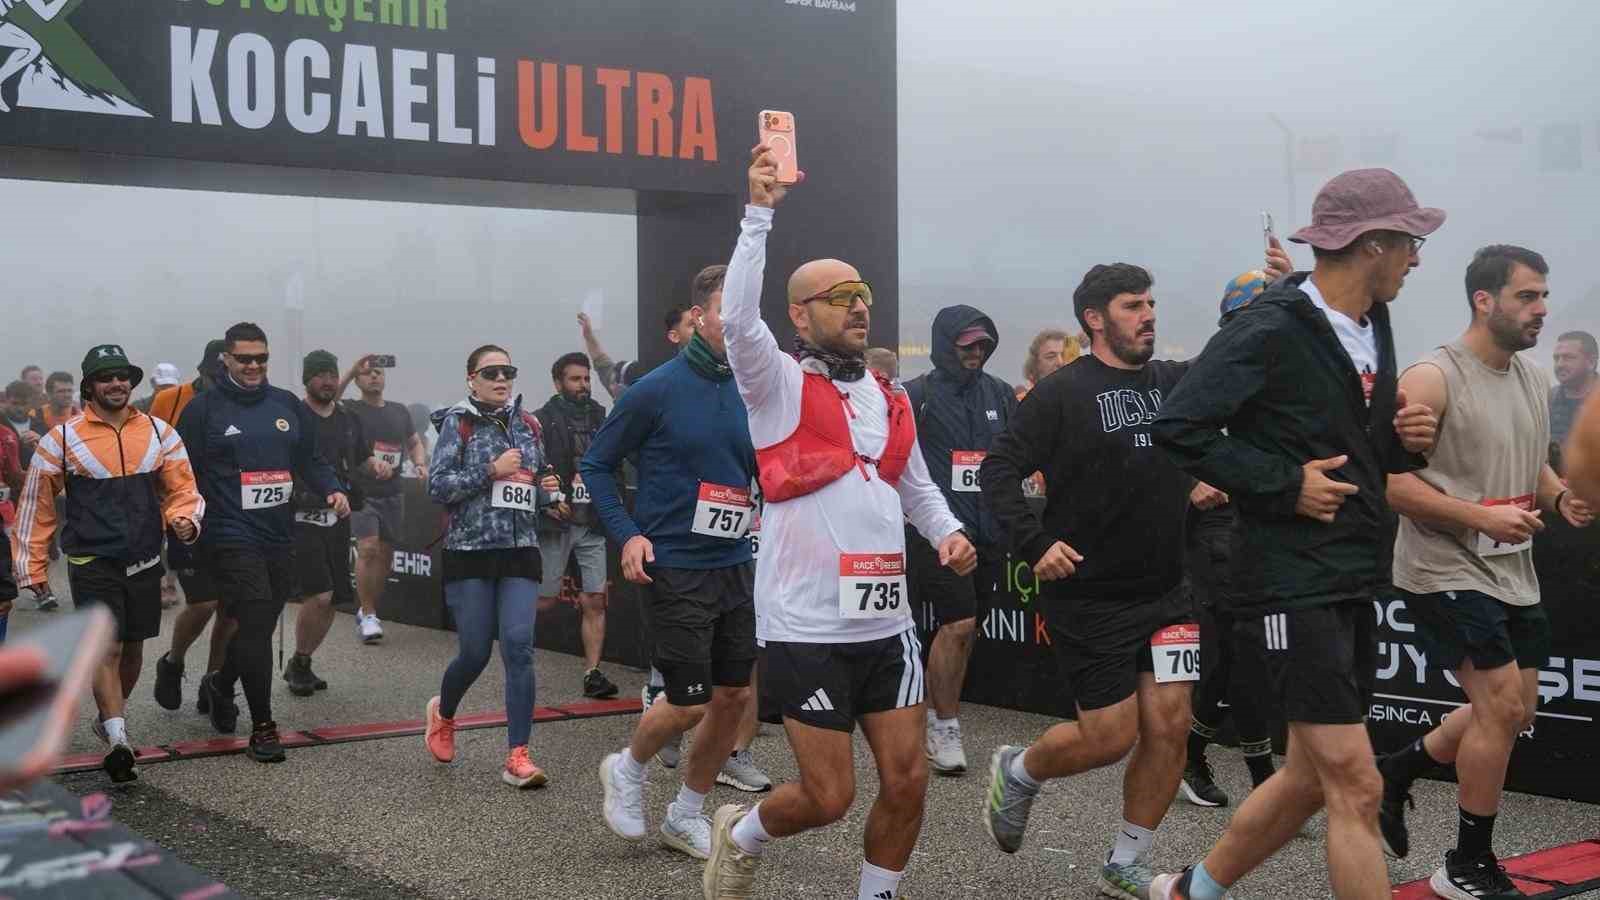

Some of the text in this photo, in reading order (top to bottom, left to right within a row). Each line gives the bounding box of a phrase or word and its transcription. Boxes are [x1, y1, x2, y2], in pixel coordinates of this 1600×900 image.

[517, 60, 718, 161] ULTRA
[252, 486, 284, 504] 725
[502, 485, 531, 505] 684
[708, 507, 744, 533] 757
[853, 560, 875, 570] RACE
[855, 582, 900, 611] 735
[1166, 649, 1200, 674] 709
